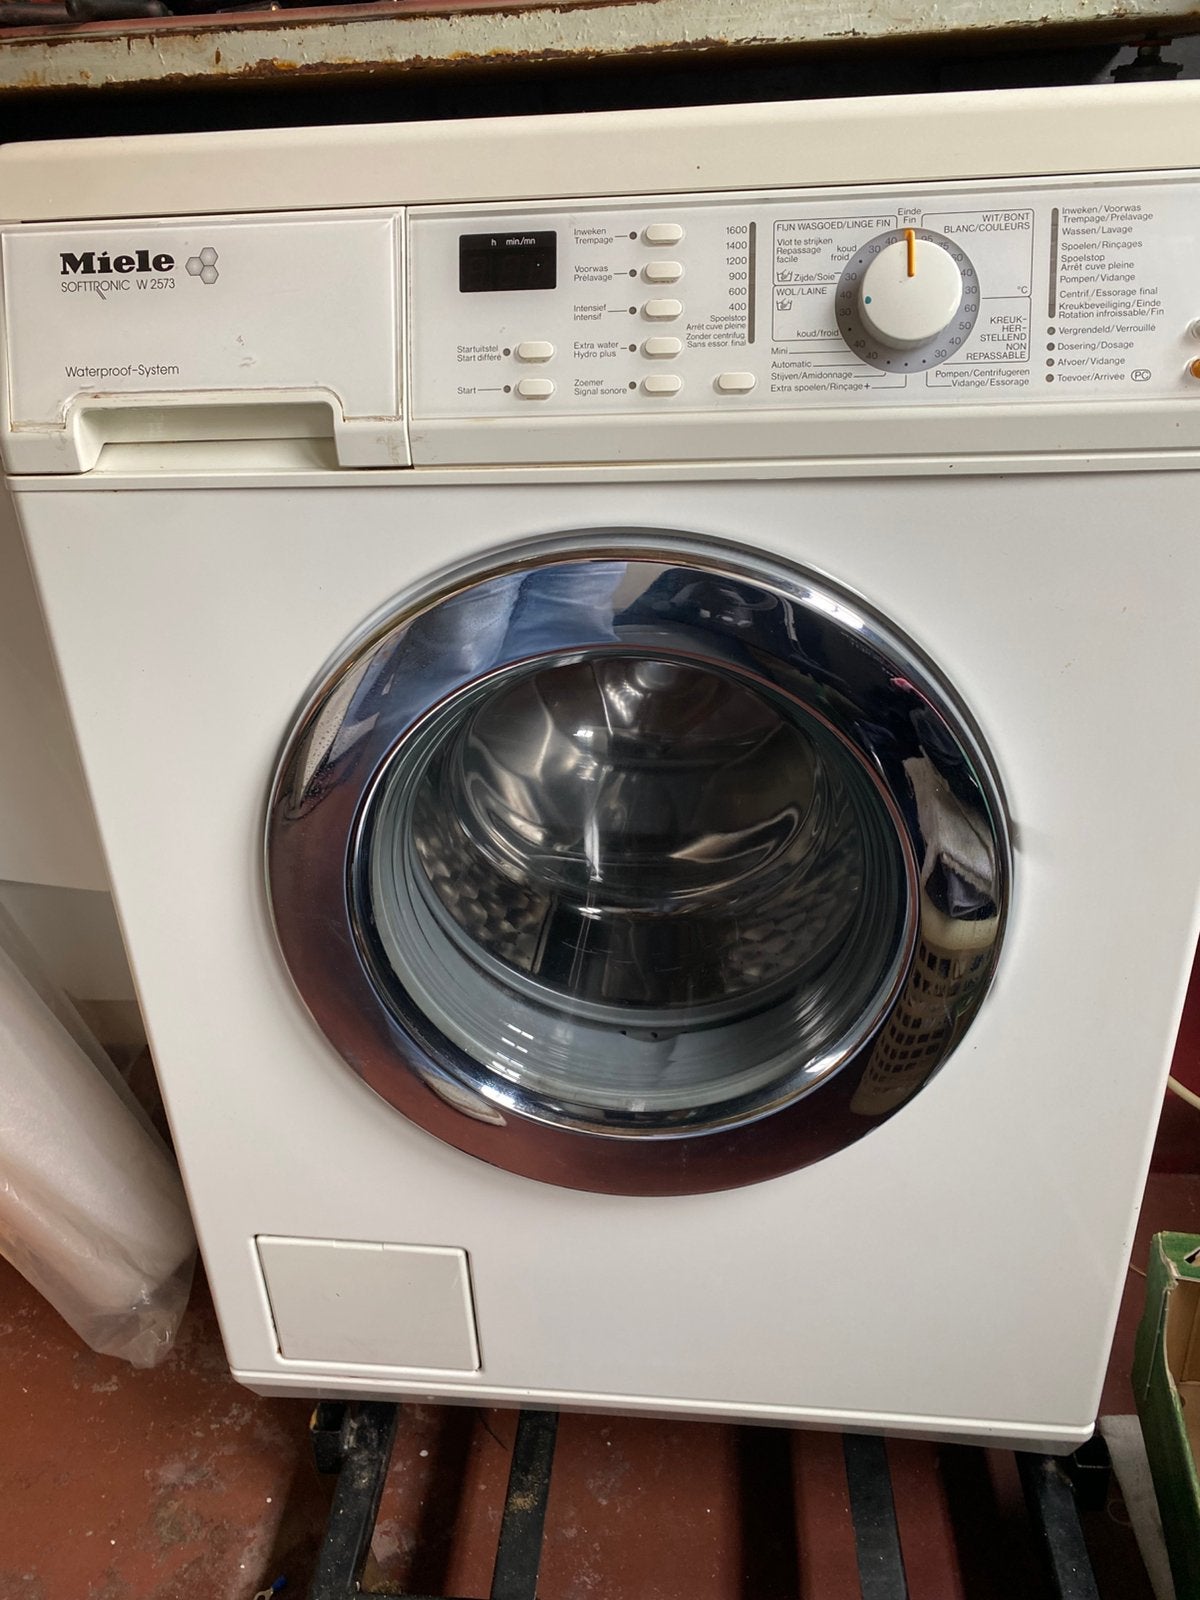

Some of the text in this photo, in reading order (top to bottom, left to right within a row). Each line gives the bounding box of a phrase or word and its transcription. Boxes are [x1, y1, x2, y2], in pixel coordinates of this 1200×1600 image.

[897, 207, 922, 216] Einde
[1061, 204, 1142, 215] Inweken/Voorwas
[903, 216, 917, 224] Fin
[982, 212, 1030, 223] WIT/BONT
[776, 219, 891, 231] FIJN WASGOED/LINGE FIN
[943, 222, 1031, 234] BLANC/COULEURS
[573, 227, 607, 237] Inweken
[725, 226, 748, 235] 1600
[1061, 226, 1133, 236] Wassen/Lavage
[491, 239, 497, 247] h
[575, 236, 614, 245] Trempage
[725, 240, 748, 250] 1400
[776, 239, 793, 247] Vlot
[803, 238, 833, 247] strijken
[885, 236, 899, 246] 40
[836, 244, 857, 253] koud
[868, 245, 881, 254] 30
[1061, 240, 1143, 251] Spoelen/Rinçages
[776, 246, 822, 256] Repassage
[725, 256, 748, 266] 1200
[776, 255, 799, 264] facile
[830, 253, 850, 262] froid
[1060, 254, 1106, 264] Spoelstop
[60, 250, 175, 275] Miele
[1085, 262, 1106, 271] cuve
[1107, 261, 1135, 271] pleine
[574, 265, 609, 273] Voorwas
[961, 268, 973, 277] 40
[728, 271, 748, 281] 900
[793, 272, 836, 283] Zijde/Soie
[844, 272, 858, 281] 30
[1059, 274, 1137, 284] Pompen/Vidange
[60, 278, 176, 300] SOFTTRONIC W 2573
[728, 287, 748, 296] 600
[776, 286, 828, 297] WOL/LAINE
[964, 285, 978, 295] 30
[1017, 285, 1029, 294] °C
[1139, 287, 1159, 296] final
[840, 290, 853, 299] 40
[573, 304, 607, 313] Intensief
[728, 302, 748, 311] 400
[964, 304, 978, 313] 60
[1059, 299, 1162, 310] Kreukbeveiliging/Einde
[840, 307, 853, 317] 30
[1058, 308, 1165, 319] Rotation infroissable/Fin
[573, 313, 602, 321] Intensif
[710, 314, 747, 323] Spoelstop
[990, 315, 1027, 325] KREUK-
[705, 322, 724, 330] cuve
[724, 321, 747, 330] pleine
[959, 321, 972, 331] 50
[1002, 324, 1027, 333] HER-
[686, 333, 712, 341] Zonder
[796, 329, 839, 339] koud/froid
[980, 332, 1027, 342] STELLEND
[573, 341, 619, 350] Extra water
[687, 341, 708, 349] Sans
[730, 338, 747, 347] final
[853, 340, 866, 348] 40
[948, 336, 962, 346] 40
[456, 345, 499, 353] Startuitstel
[771, 347, 789, 355] Mini
[1006, 343, 1027, 351] NON
[1057, 341, 1135, 352] Dosering/Dosage
[456, 354, 476, 362] Start
[573, 350, 617, 359] Hydro plus
[865, 352, 879, 360] 40
[934, 349, 948, 359] 30
[966, 352, 1026, 361] REPASSABLE
[771, 360, 812, 369] Automatic
[1057, 358, 1126, 368] Afvoer/Vidange
[65, 364, 180, 379] Waterproof-System
[935, 368, 1031, 379] Pompen/Centrifugeren
[1134, 371, 1149, 380] PC
[771, 371, 853, 382] Stijven/Amidonnage
[574, 379, 604, 387] Zoemer
[951, 378, 1030, 389] Vidange/Essorage
[457, 386, 476, 395] Start
[574, 387, 628, 396] Signal sonore
[771, 384, 793, 393] Extra
